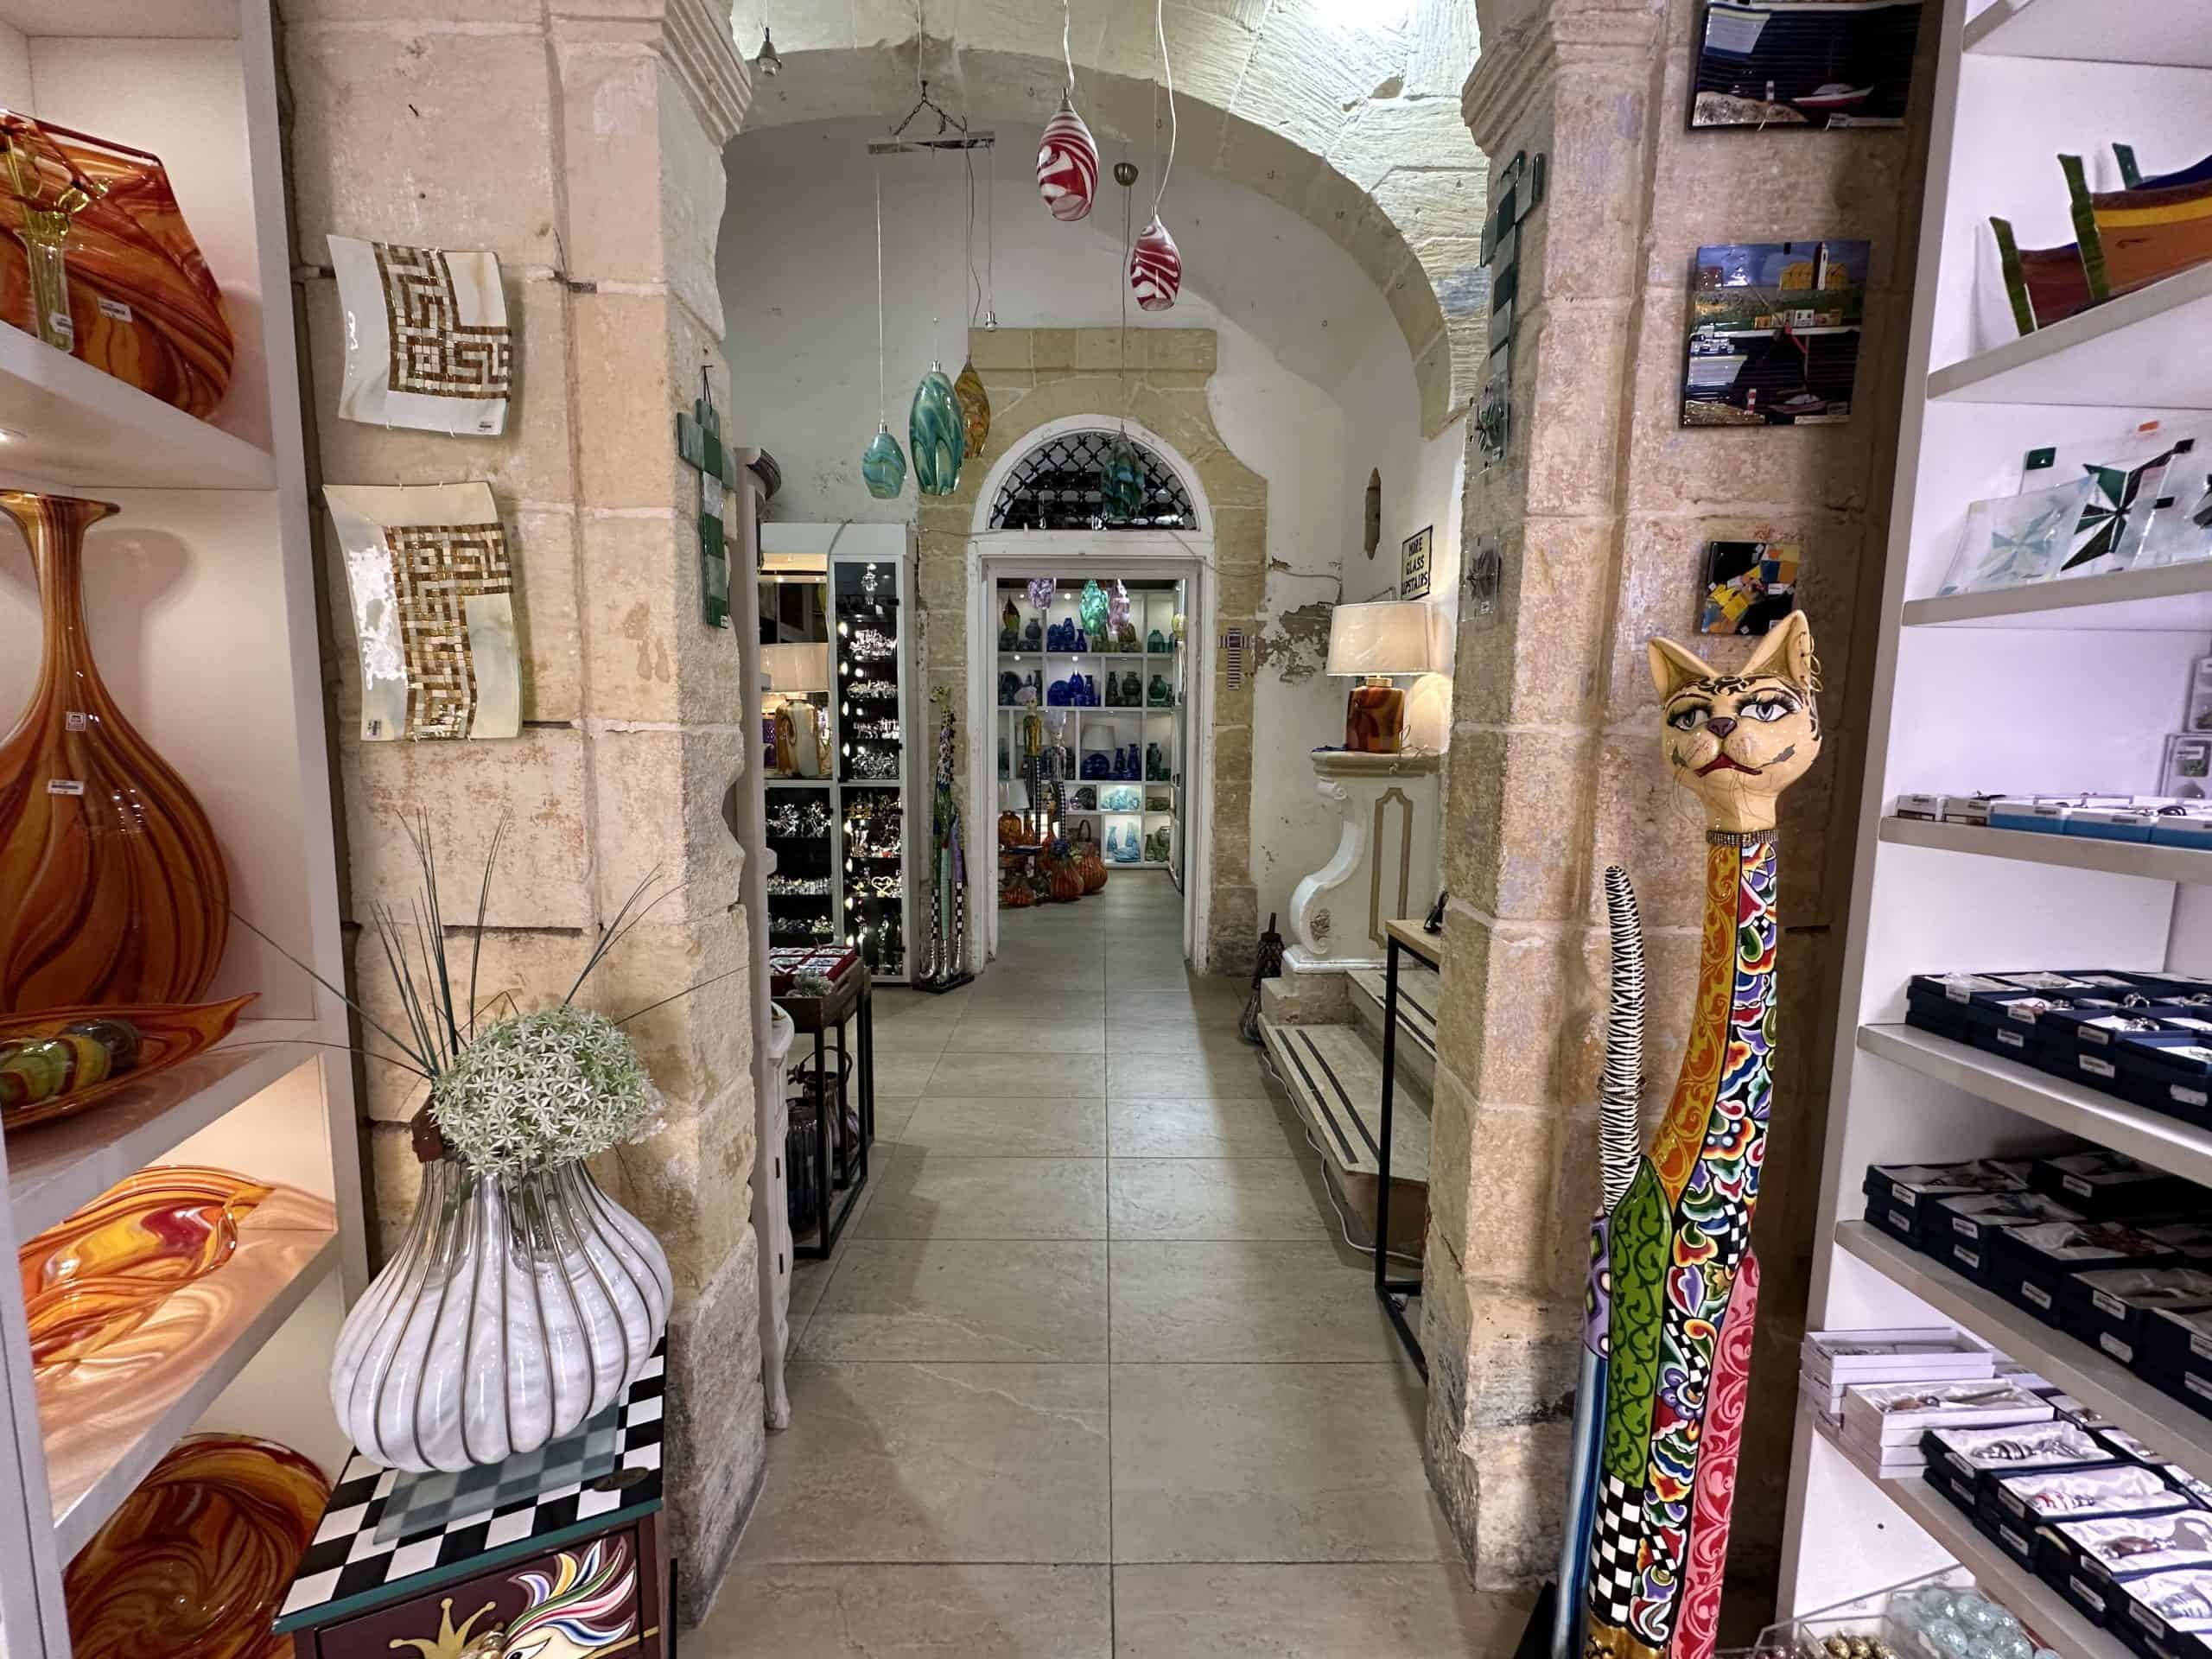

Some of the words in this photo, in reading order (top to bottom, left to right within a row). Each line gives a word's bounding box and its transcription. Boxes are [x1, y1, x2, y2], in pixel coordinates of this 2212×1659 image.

[1408, 537, 1423, 557] MORE
[1406, 555, 1425, 575] GLASS
[1402, 571, 1428, 594] UPSTAIRS
